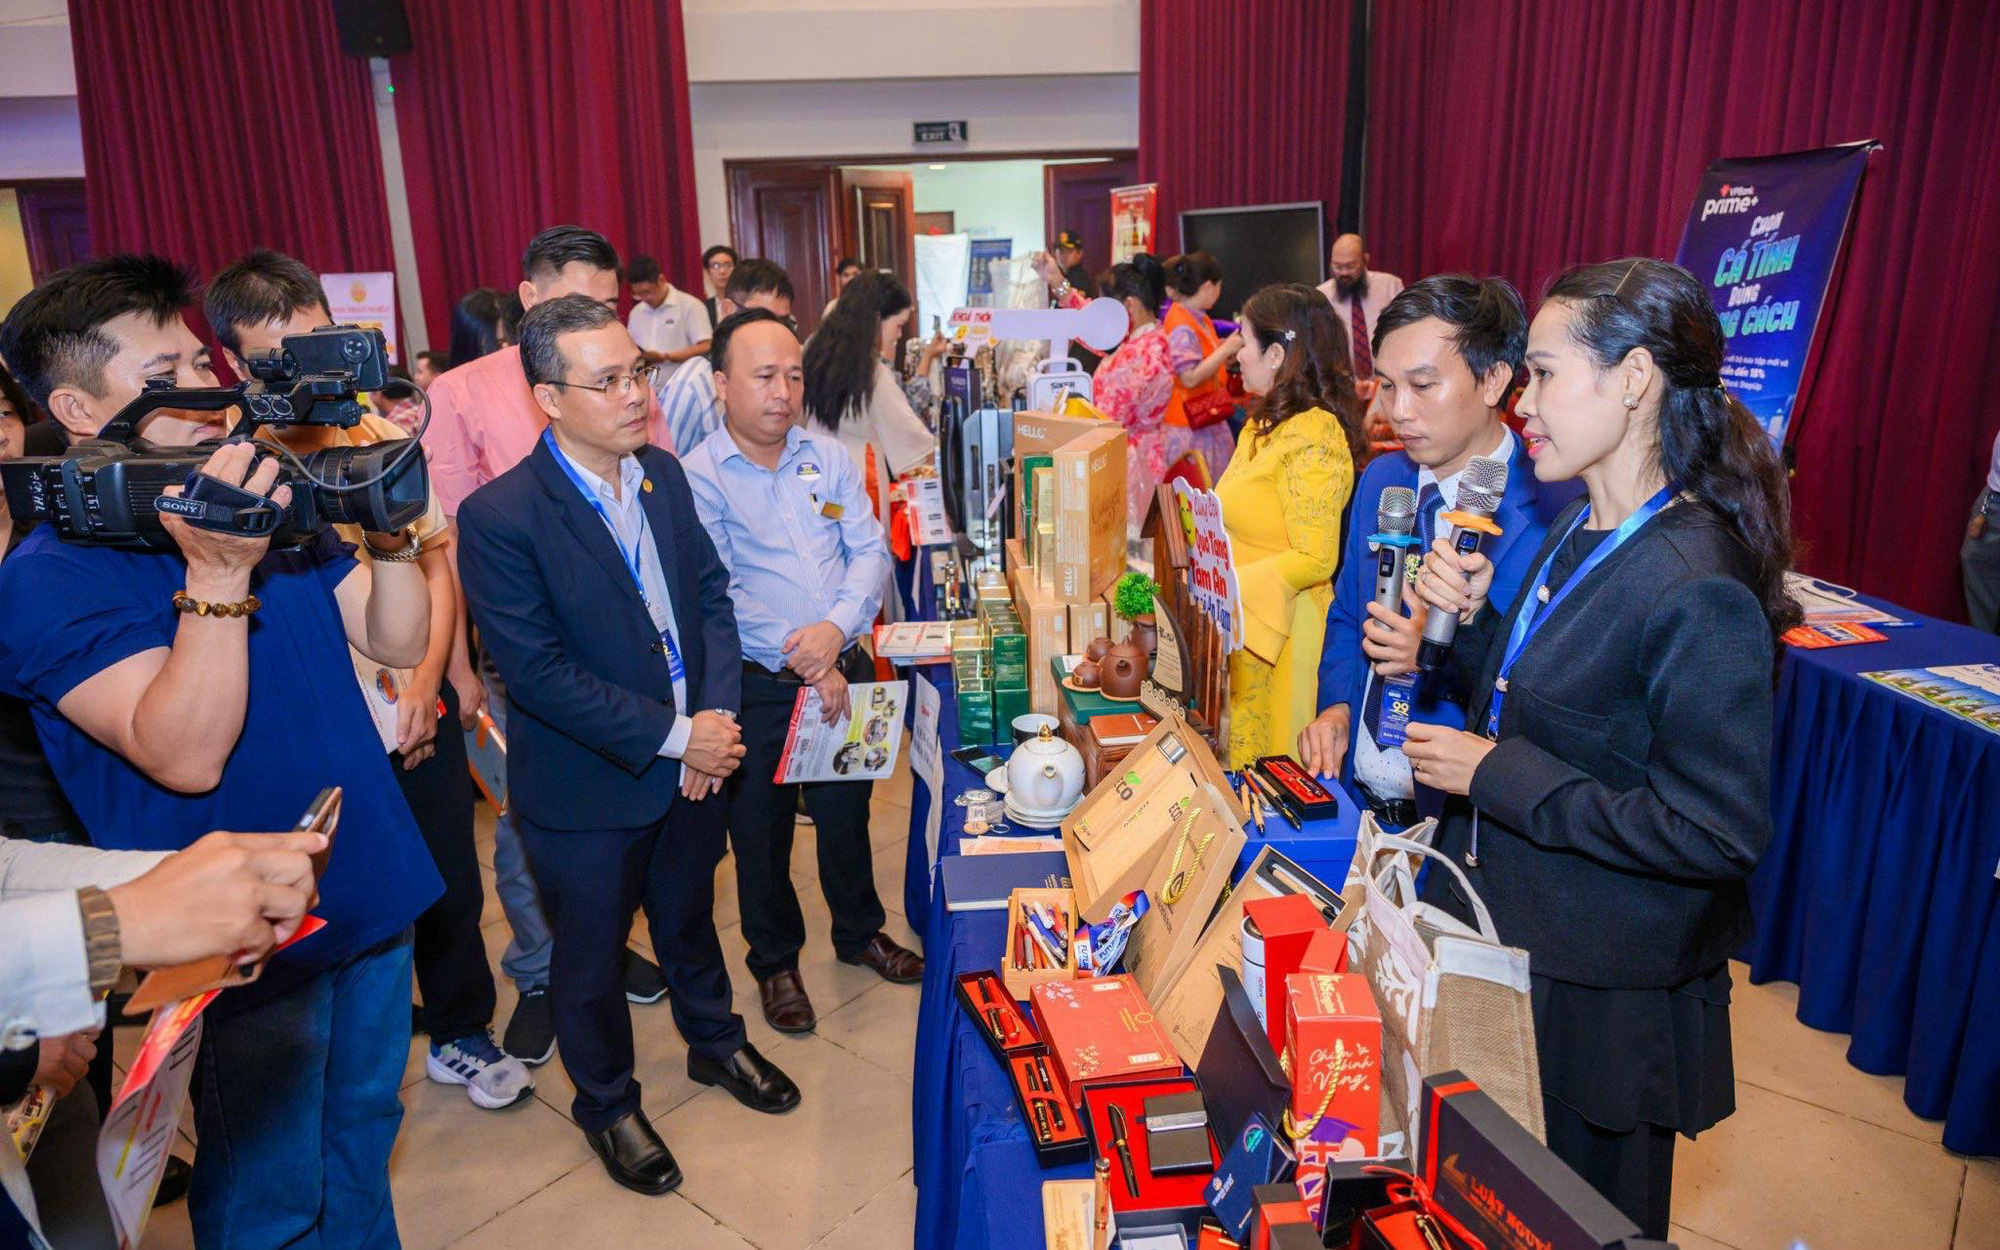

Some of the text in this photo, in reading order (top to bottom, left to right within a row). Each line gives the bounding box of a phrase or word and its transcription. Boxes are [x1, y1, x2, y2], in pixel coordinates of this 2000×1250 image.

[1701, 196, 1759, 222] prime+
[1750, 211, 1785, 237] CHỌN
[1713, 231, 1801, 288] CÁ TÍNH
[1741, 295, 1800, 336] CÁCH
[161, 501, 198, 514] SONY
[1195, 527, 1230, 571] Quà Tặng
[1189, 556, 1212, 591] Tâm
[1168, 802, 1183, 822] ECO
[1310, 1048, 1354, 1066] Chin
[1313, 1071, 1368, 1092] Vng
